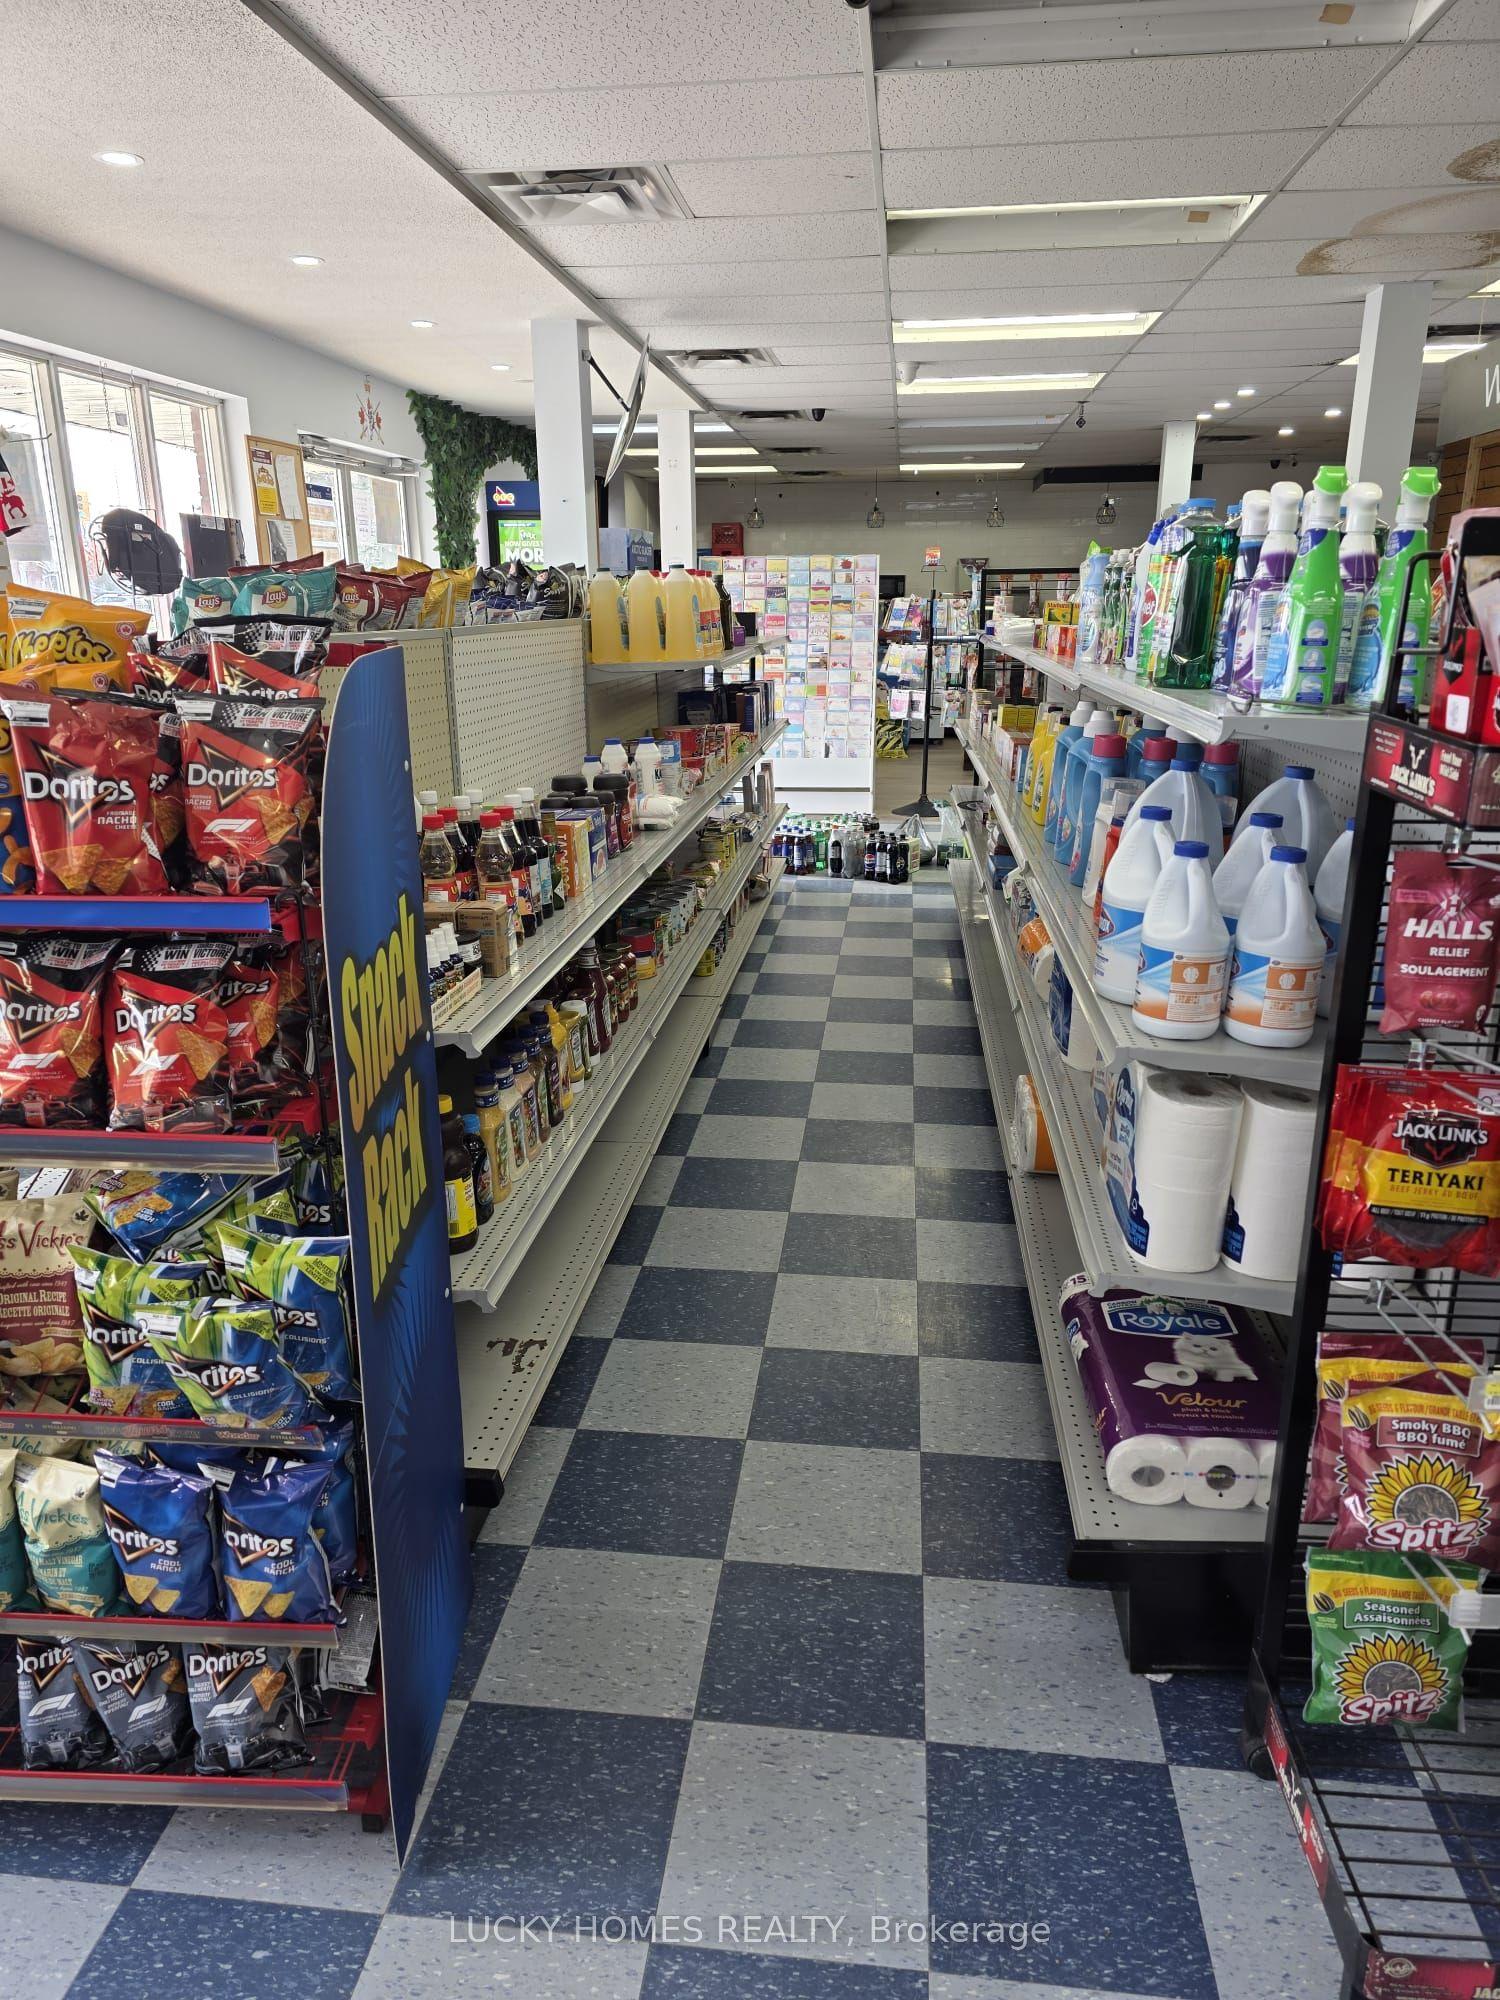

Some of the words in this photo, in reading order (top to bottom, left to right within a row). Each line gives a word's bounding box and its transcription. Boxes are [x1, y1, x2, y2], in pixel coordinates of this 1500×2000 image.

[198, 596, 220, 608] Lay's
[265, 590, 287, 604] Lay's
[342, 592, 360, 604] Lay's
[265, 630, 285, 641] WIN
[243, 708, 266, 718] WIN
[272, 710, 310, 723] VICTOIRE
[188, 763, 278, 788] Doritos
[24, 771, 136, 801] Doritos
[97, 816, 137, 825] NACHO
[1403, 918, 1493, 941] HALLS
[52, 947, 78, 960] WIN
[164, 949, 189, 960] WIN
[193, 949, 231, 960] VICTOIRE
[1429, 947, 1470, 958] RELIEF
[1400, 963, 1490, 977] SOULAGEMENT
[115, 1004, 197, 1033] Doritos
[341, 893, 424, 1134] Snack
[1392, 1119, 1437, 1141] JACK
[1438, 1122, 1489, 1145] LINK'S
[362, 1066, 428, 1304] Rack
[1387, 1167, 1486, 1191] TERIYAKI
[1390, 1184, 1409, 1194] BEEF
[1412, 1185, 1440, 1196] JERKY
[1442, 1188, 1454, 1198] AU
[18, 1220, 84, 1257] Vickie's
[39, 1289, 67, 1303] RECIPE
[33, 1304, 70, 1317] ORIGINALE
[1118, 1311, 1222, 1332] Royale
[86, 1326, 153, 1348] orit
[284, 1334, 328, 1345] COLLISIONS
[165, 1361, 261, 1388] Doritos
[1155, 1391, 1248, 1408] Velour
[1391, 1419, 1438, 1434] Smoky
[1442, 1422, 1472, 1440] BBQ
[1396, 1431, 1428, 1445] BBQ
[1431, 1434, 1466, 1450] fumé
[1370, 1519, 1478, 1552] Spitz
[150, 1562, 182, 1573] RANCH
[158, 1558, 182, 1567] COOL
[271, 1559, 295, 1569] COOL
[263, 1565, 295, 1576] RANCH
[1363, 1601, 1421, 1614] Seasoned
[1354, 1612, 1432, 1627] Assaisonnées
[16, 1646, 74, 1674] orito
[189, 1646, 267, 1677] Doritos
[91, 1643, 170, 1692] Doritos
[1342, 1689, 1440, 1724] Spitz
